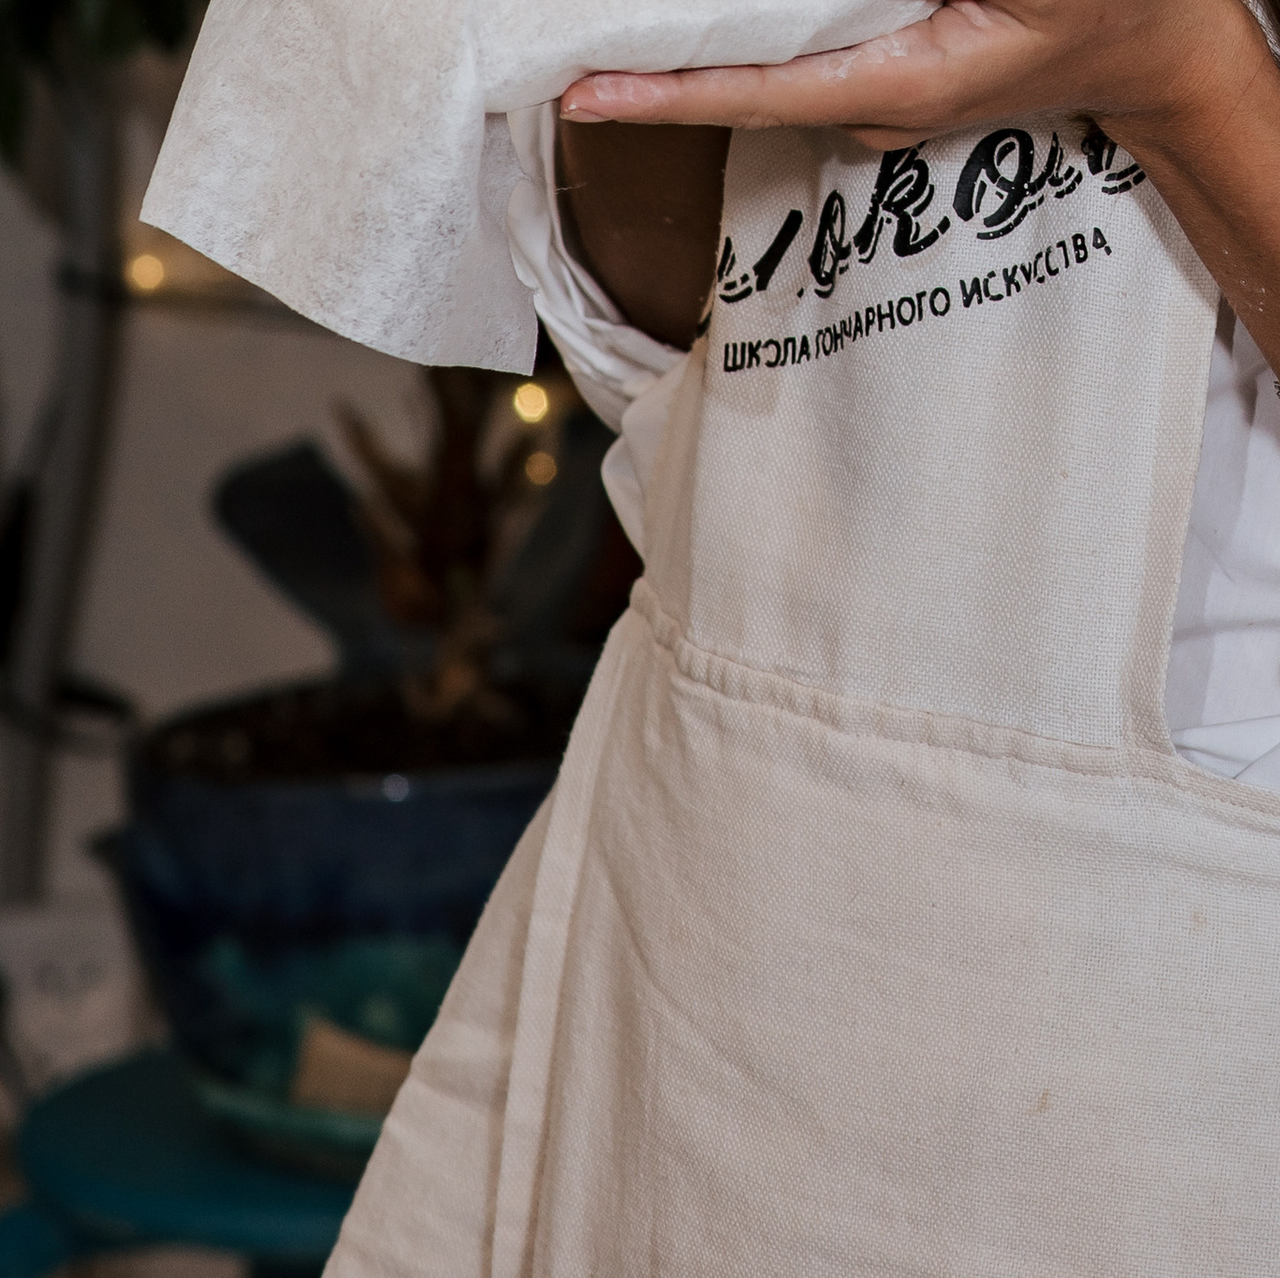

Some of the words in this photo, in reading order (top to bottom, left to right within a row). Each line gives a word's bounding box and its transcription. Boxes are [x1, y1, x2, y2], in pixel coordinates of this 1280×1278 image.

[723, 334, 810, 372] ШКОЛА
[815, 287, 950, 359] ГОНЧАРНОГО
[959, 227, 1112, 308] ИСКУССТВА
